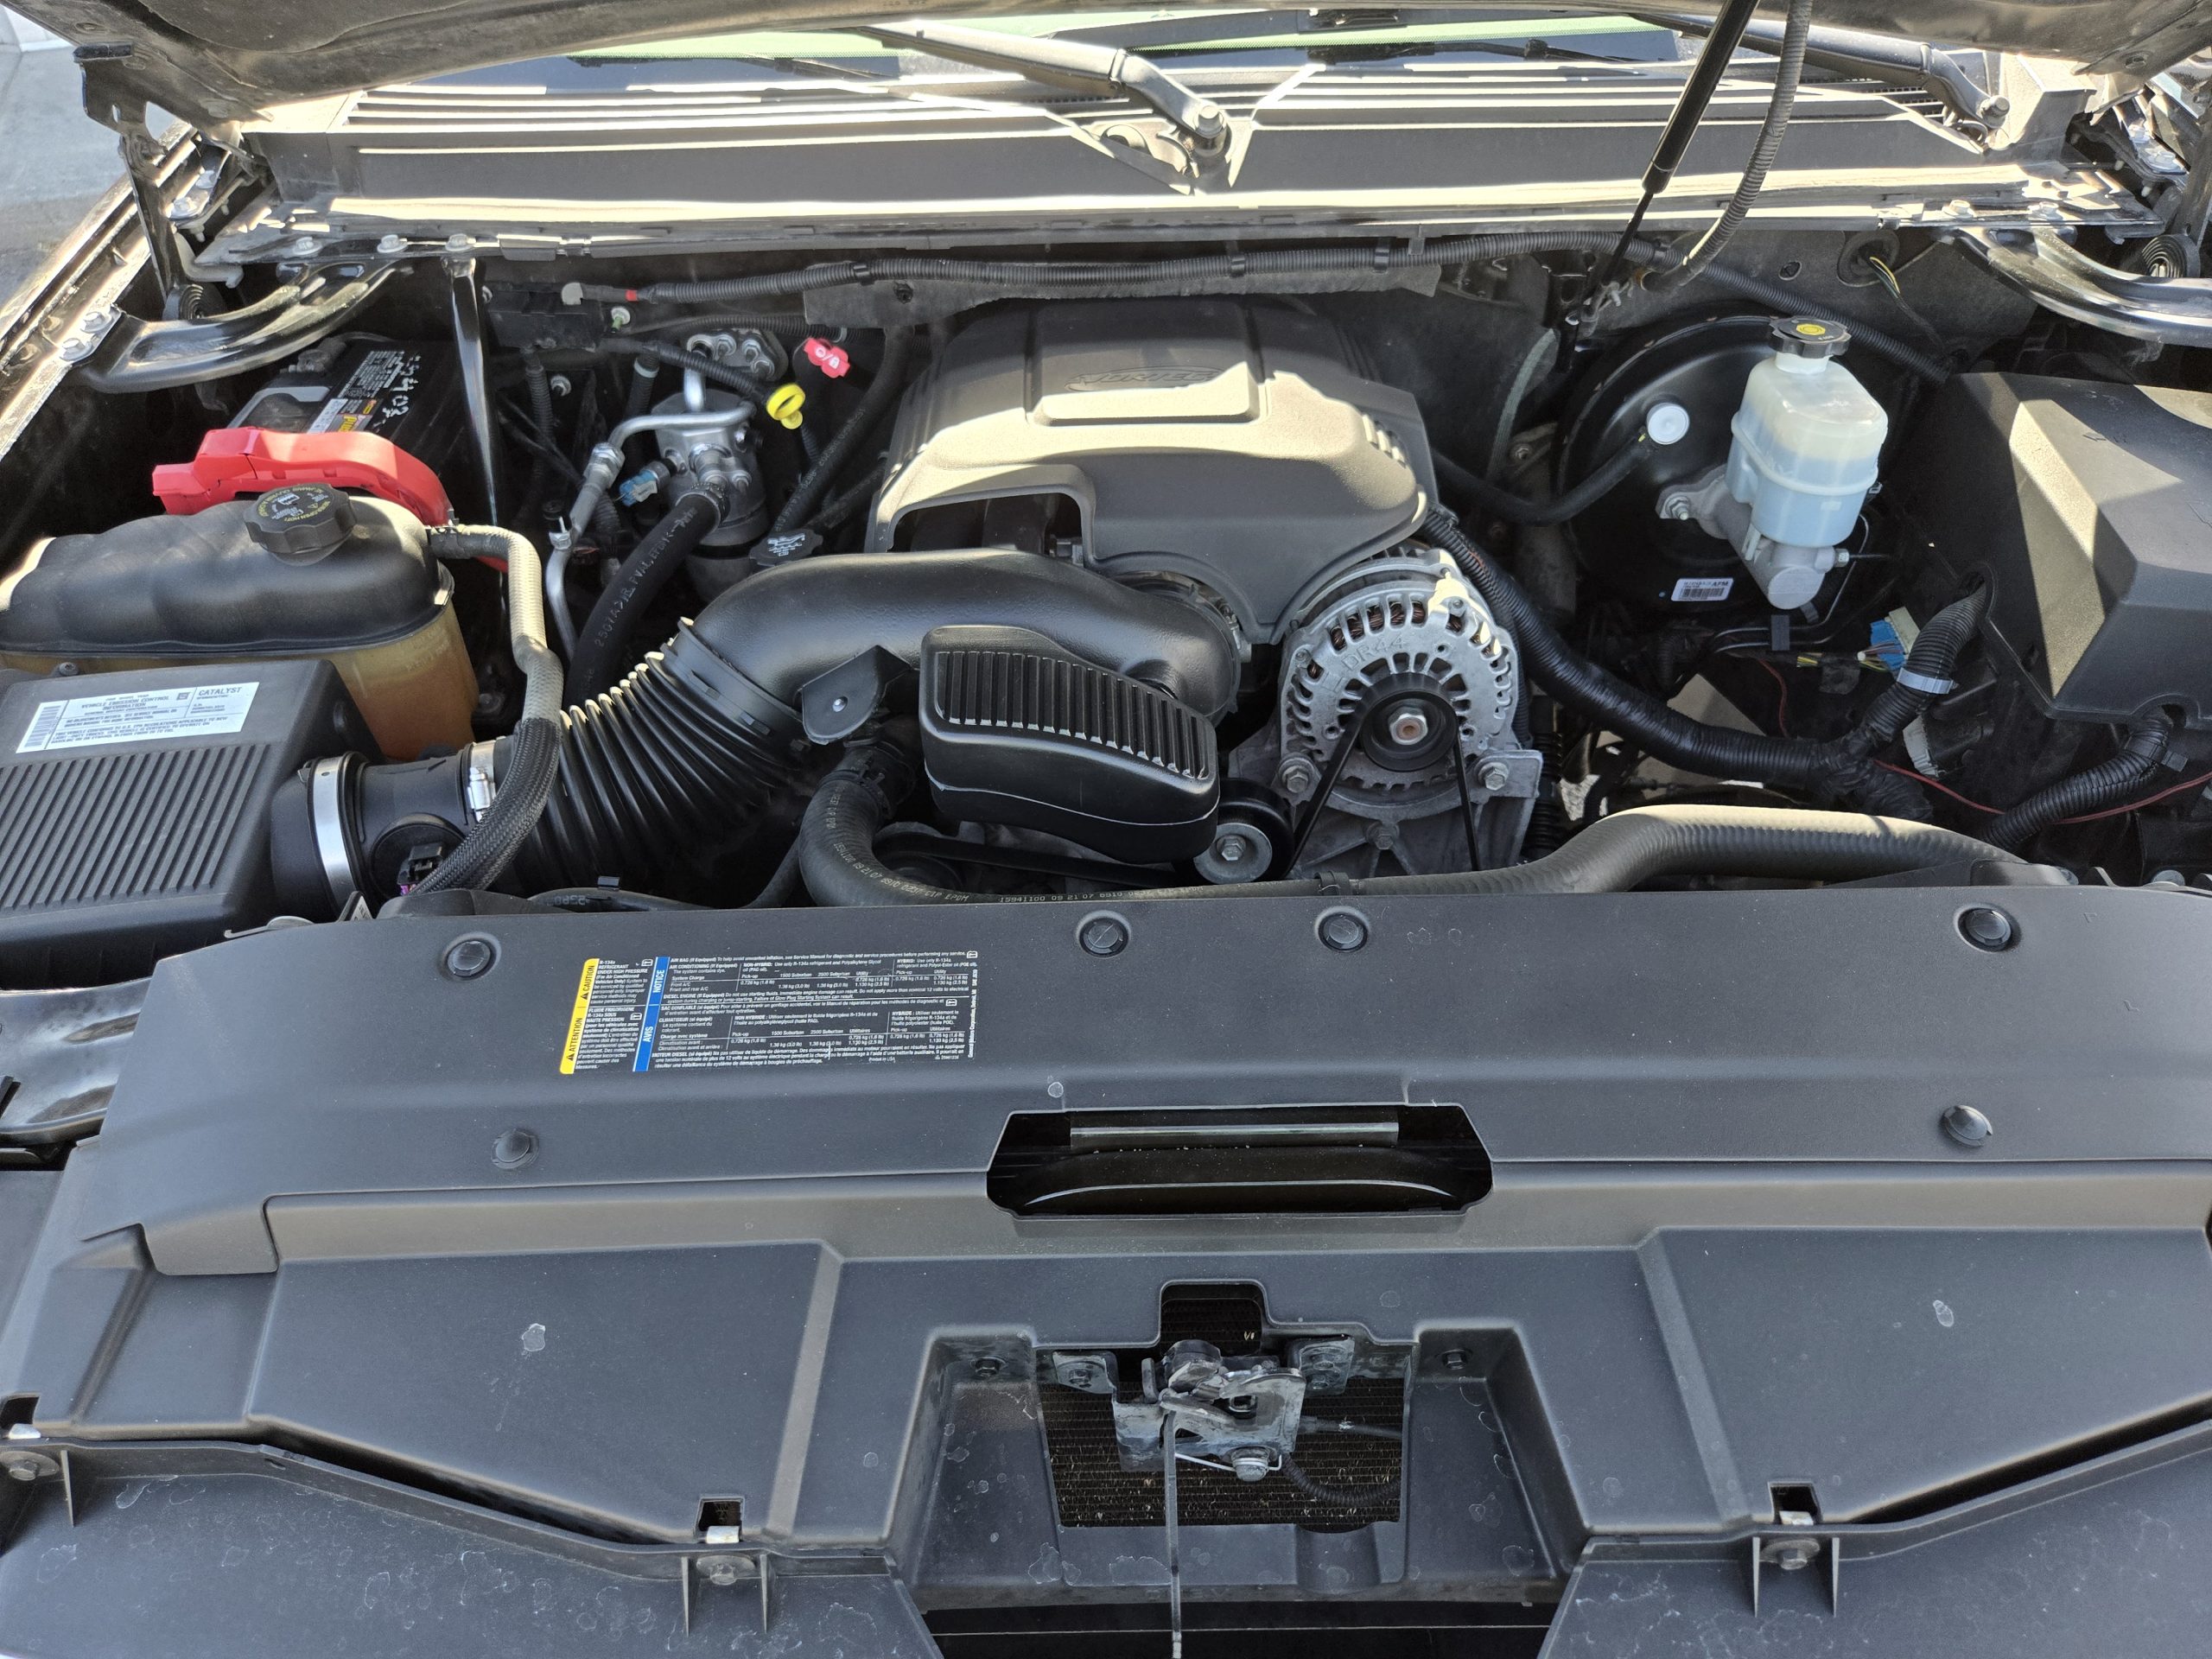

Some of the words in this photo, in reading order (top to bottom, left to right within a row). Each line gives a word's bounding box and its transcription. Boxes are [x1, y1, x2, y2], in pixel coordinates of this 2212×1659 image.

[199, 687, 242, 696] CATALYST
[583, 965, 594, 991] CAUTION
[652, 969, 664, 993] NOTICE
[569, 1018, 582, 1052] ATTENTION
[643, 1026, 653, 1042] AVIS
